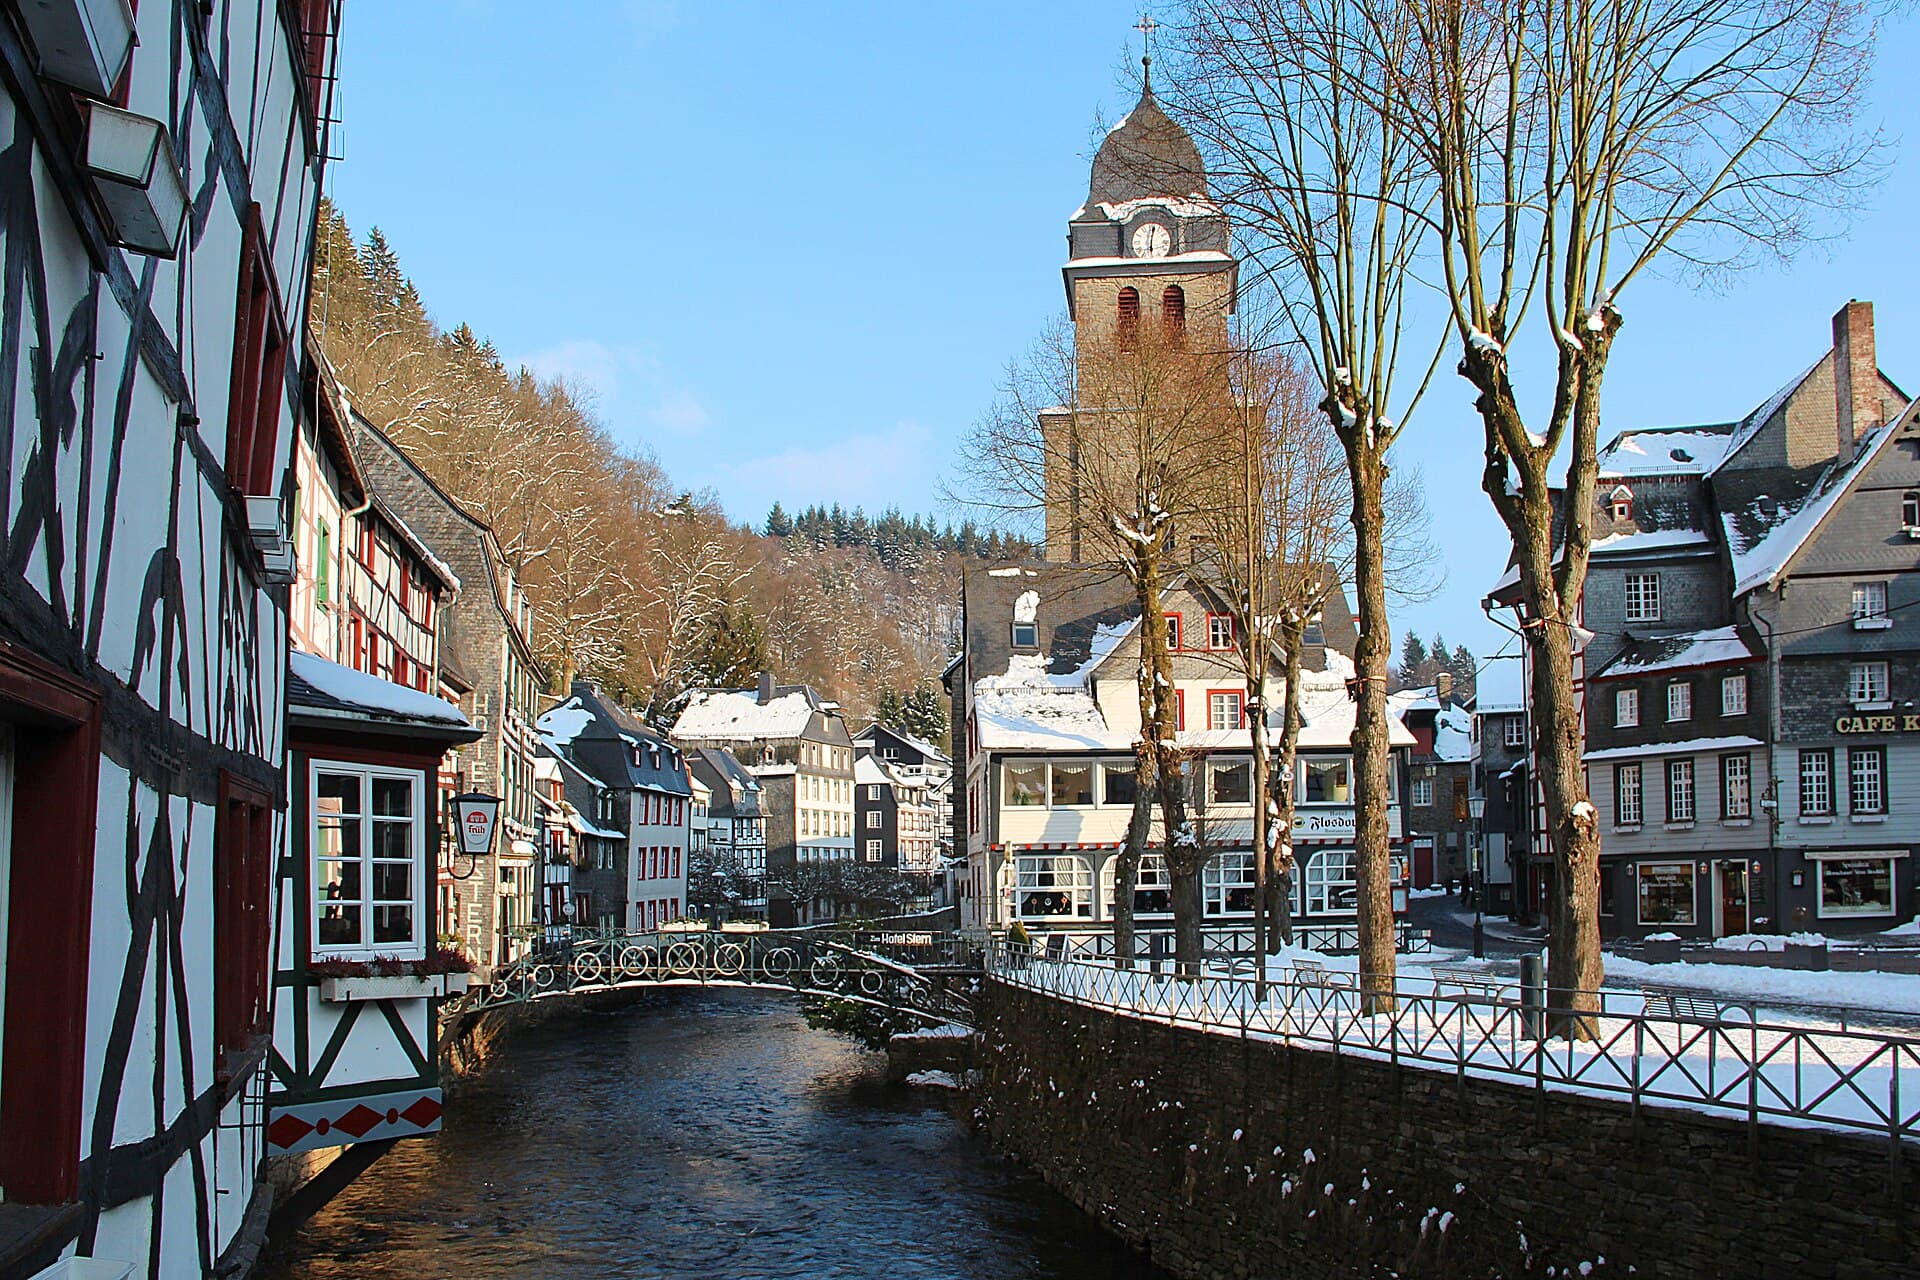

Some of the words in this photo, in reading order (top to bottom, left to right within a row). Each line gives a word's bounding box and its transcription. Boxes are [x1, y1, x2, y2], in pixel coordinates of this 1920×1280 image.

[1836, 716, 1896, 733] CAFE
[881, 933, 905, 944] Hotel
[906, 933, 932, 945] Stern
